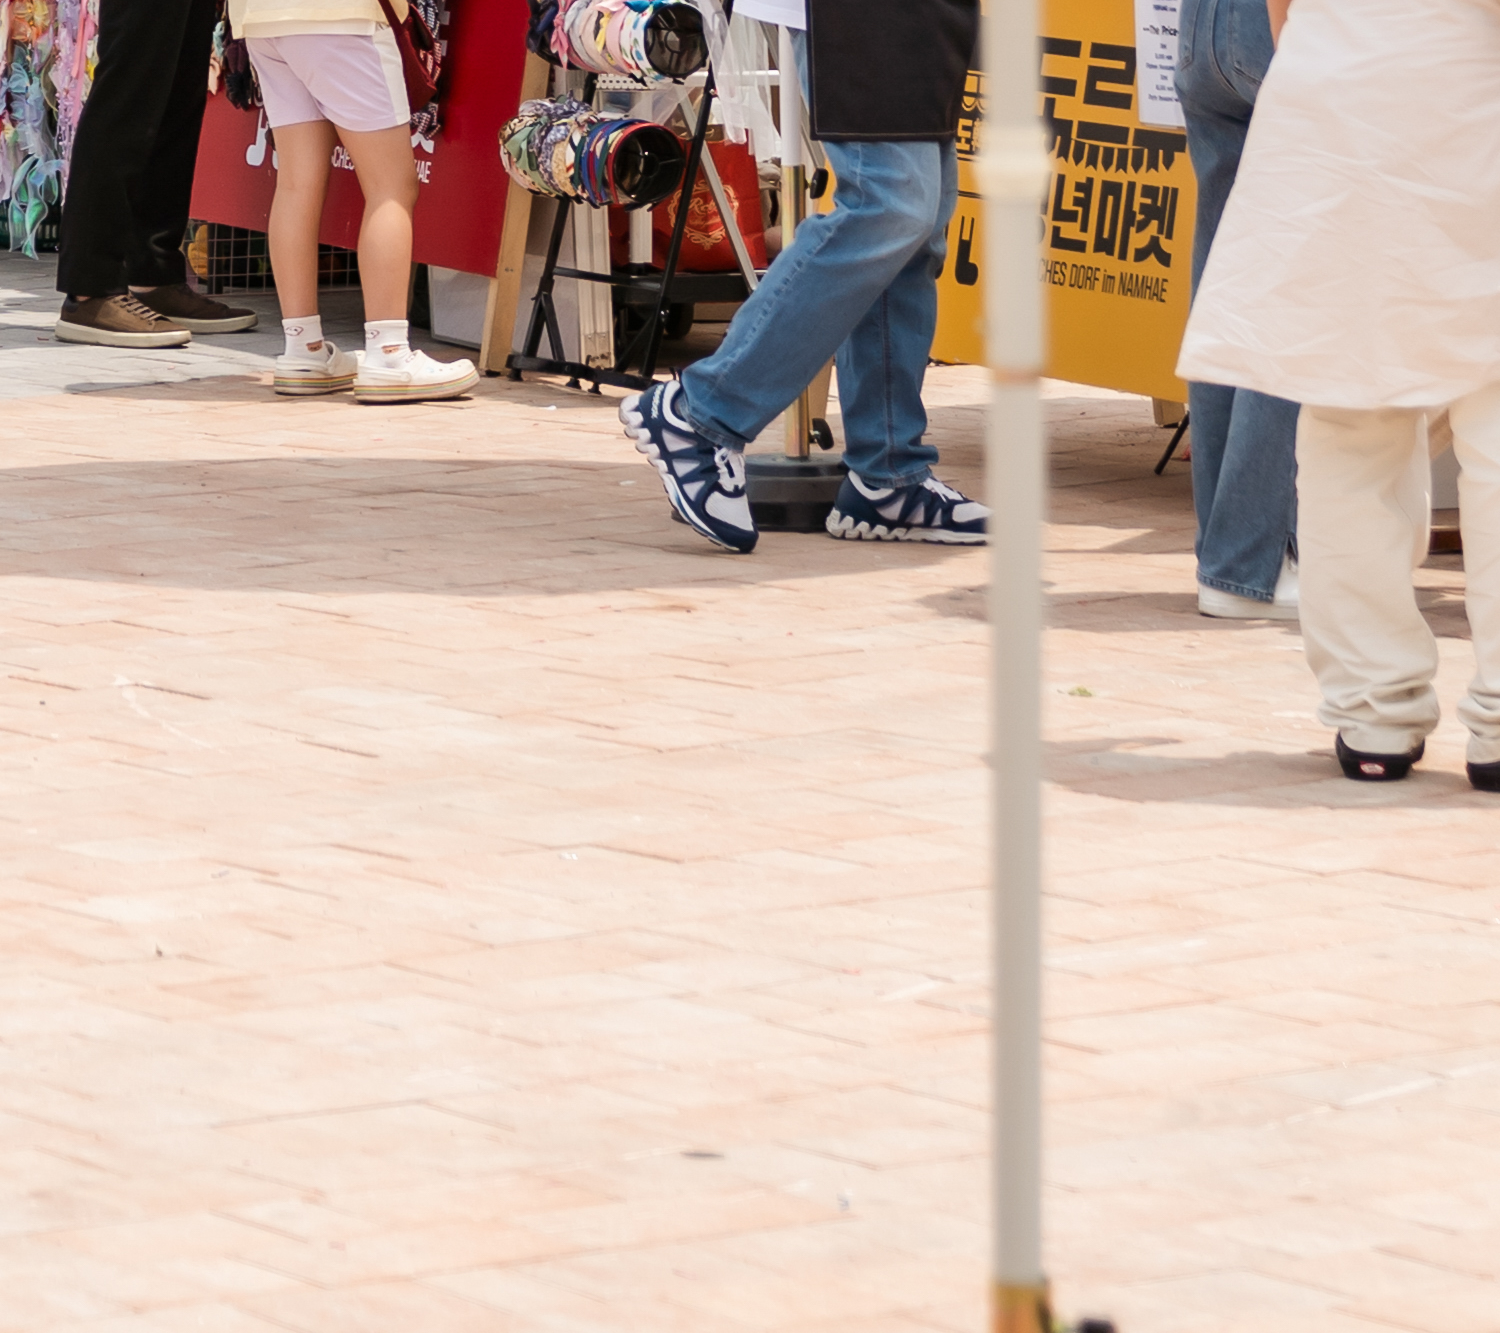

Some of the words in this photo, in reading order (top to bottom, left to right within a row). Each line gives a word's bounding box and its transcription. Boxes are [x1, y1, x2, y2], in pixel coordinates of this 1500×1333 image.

[1040, 171, 1180, 269] 년마켓
[1069, 264, 1101, 292] DORF
[1102, 269, 1116, 295] im
[1118, 271, 1169, 304] NAMHAE
